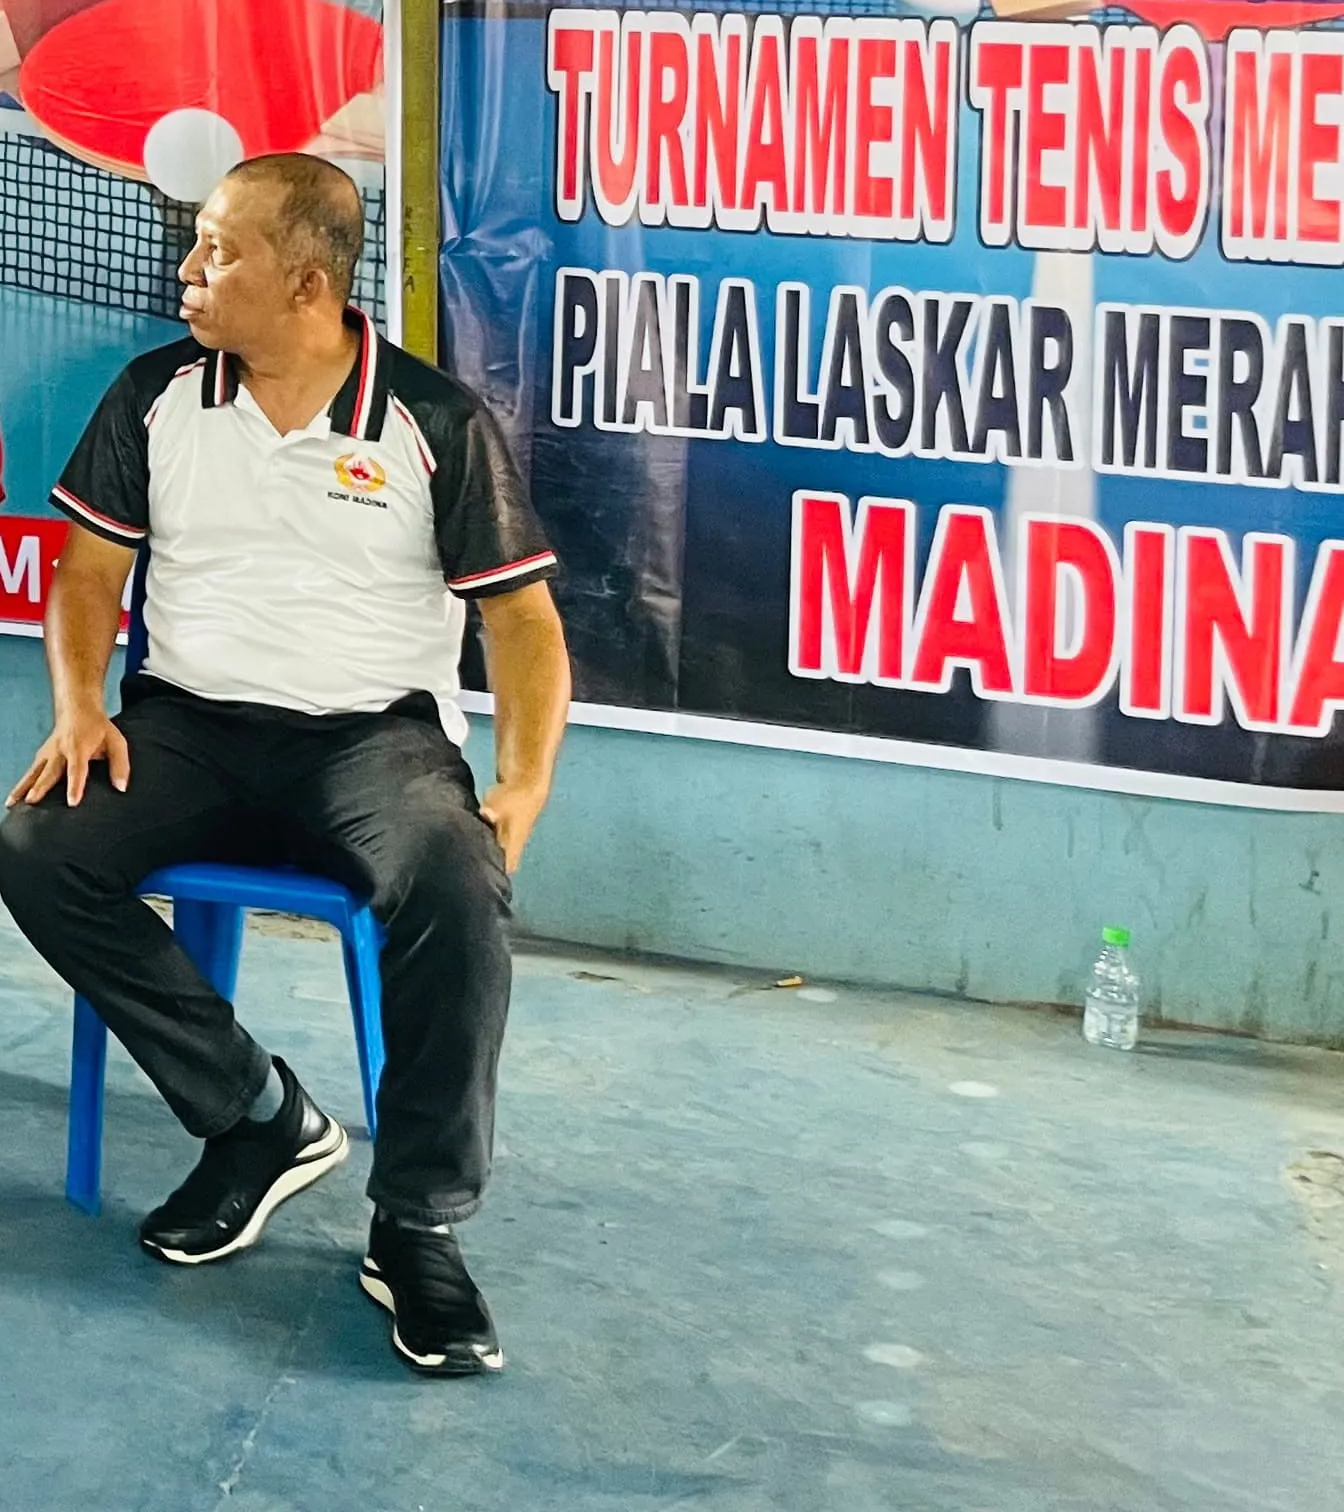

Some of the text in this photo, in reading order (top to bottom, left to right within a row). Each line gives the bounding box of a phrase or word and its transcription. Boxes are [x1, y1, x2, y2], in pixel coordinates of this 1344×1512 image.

[552, 23, 1344, 244] TURNAMEN TENIS ME
[558, 275, 759, 436] PIALA
[782, 285, 1076, 465] LASKAR
[796, 496, 1344, 731] MADINA
